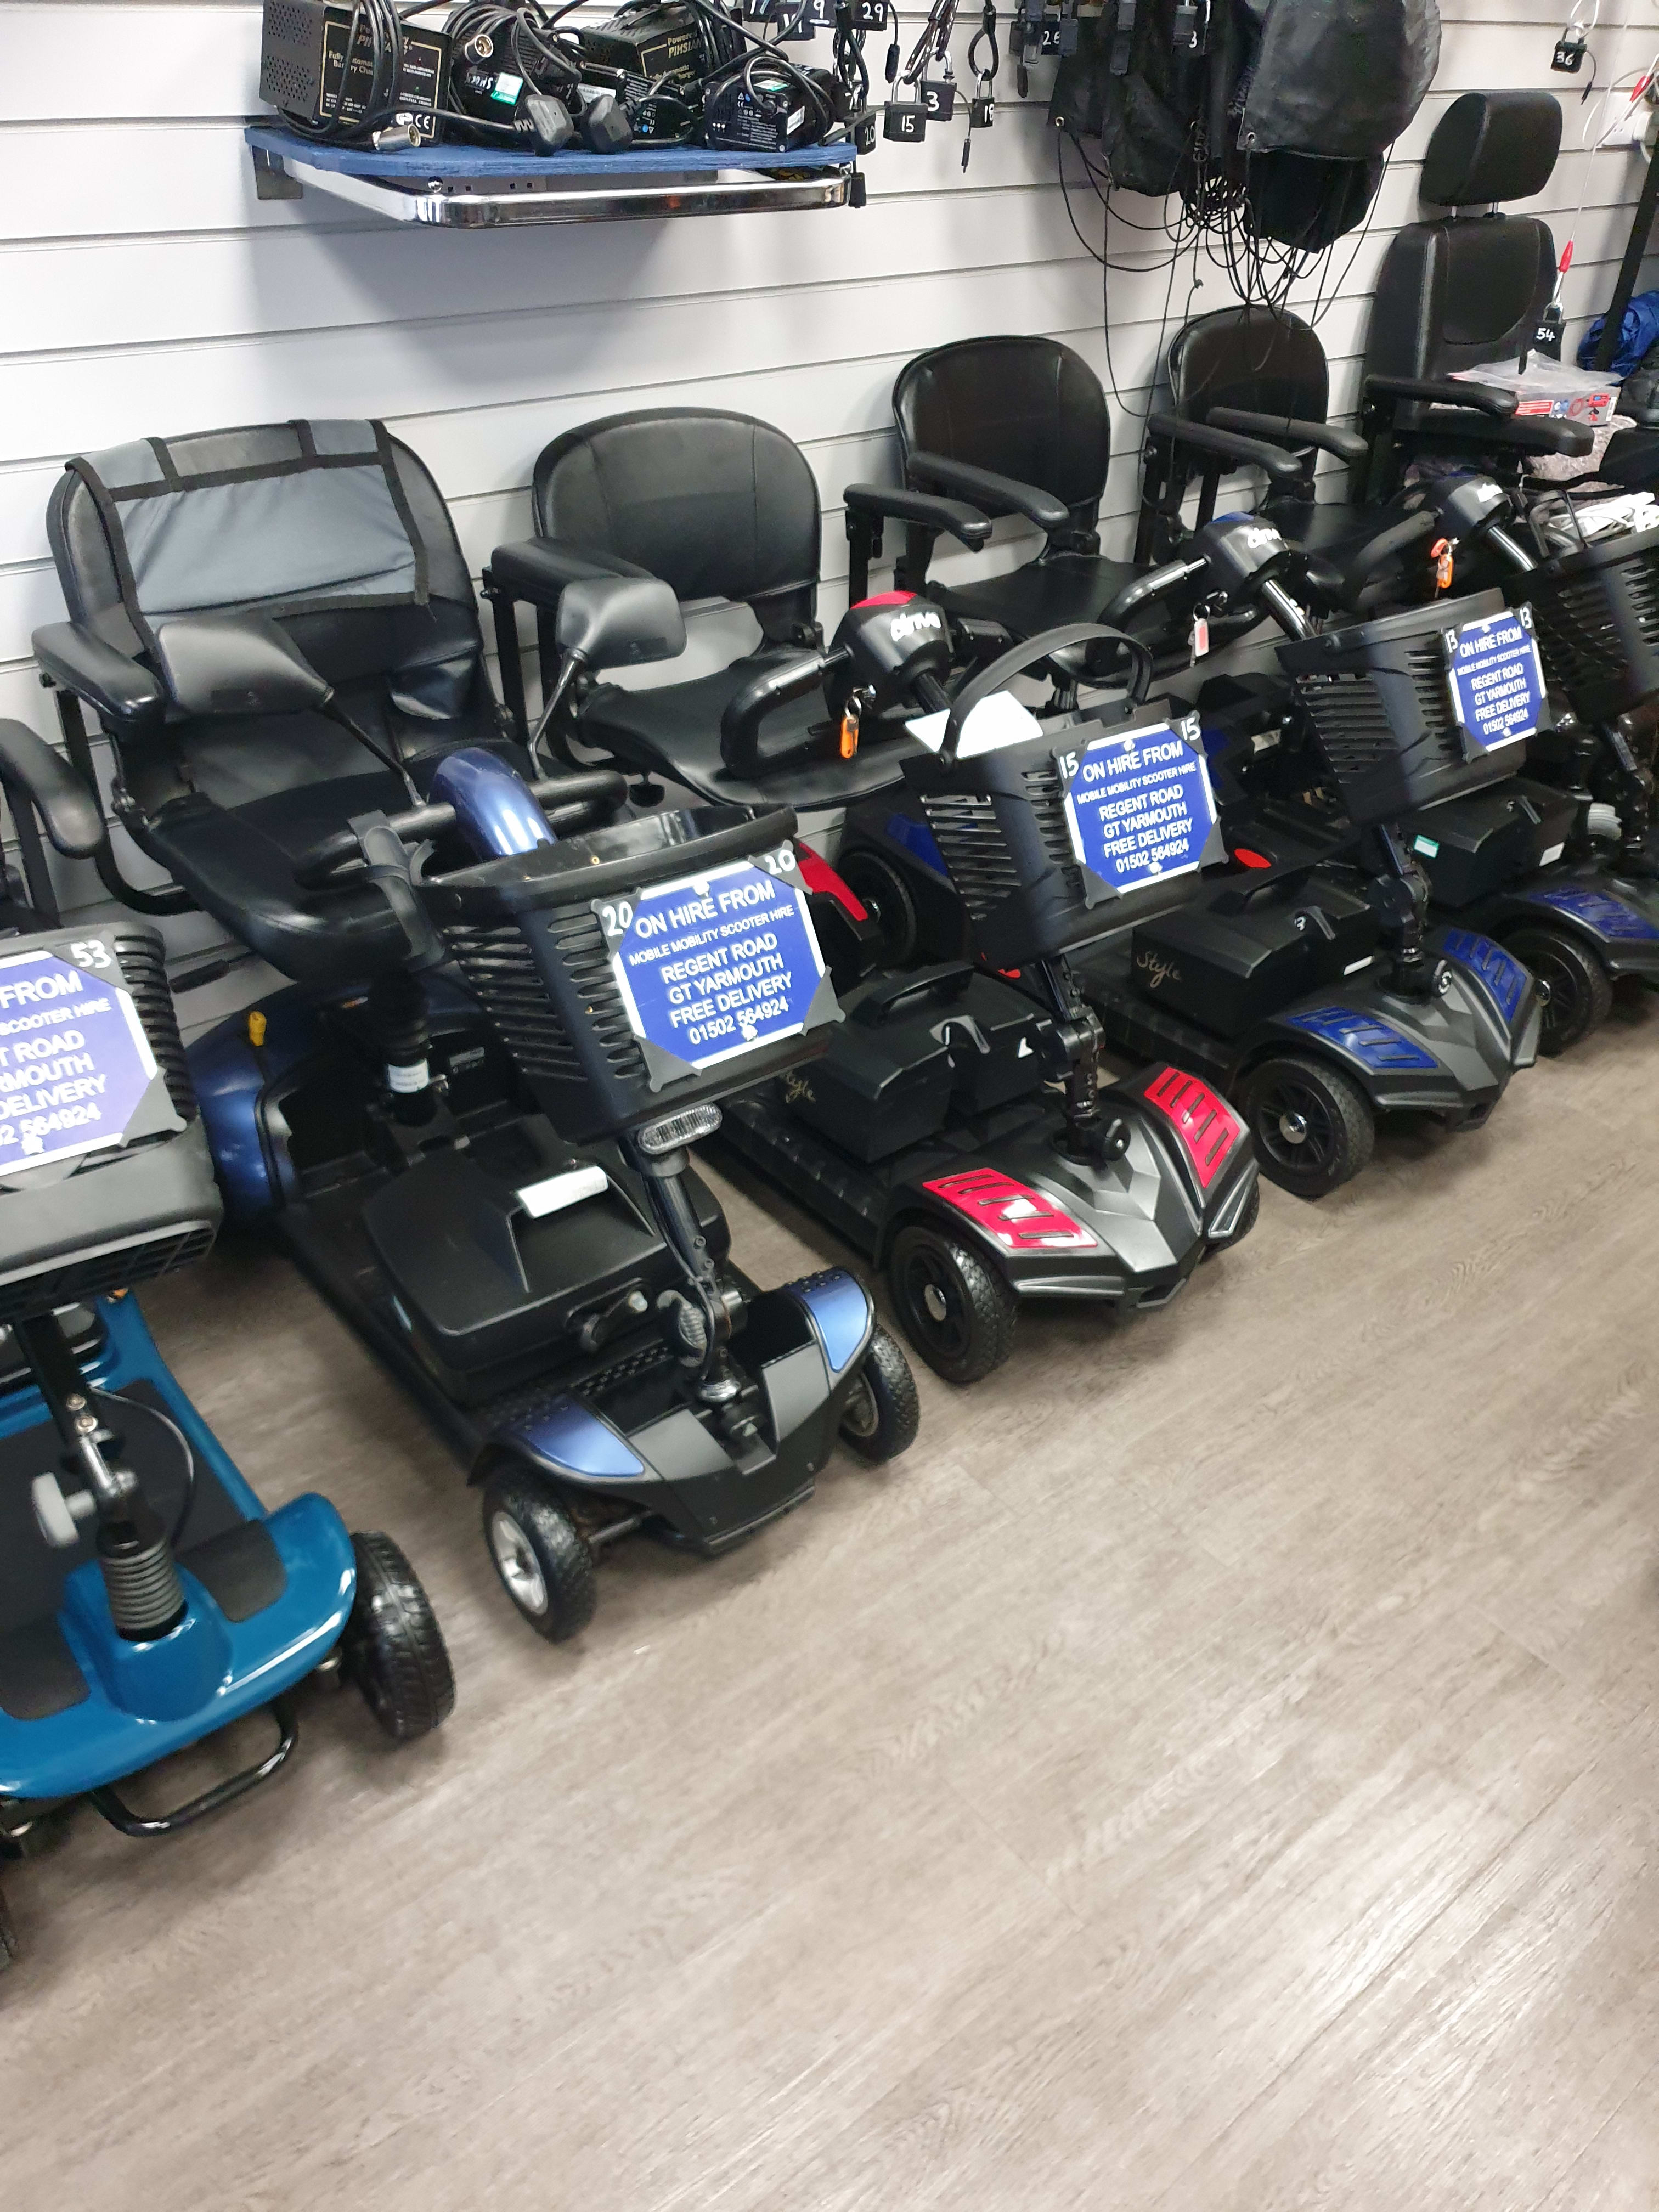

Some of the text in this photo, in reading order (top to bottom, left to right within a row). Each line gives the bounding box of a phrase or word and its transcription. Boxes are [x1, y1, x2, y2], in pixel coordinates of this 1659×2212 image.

[861, 2, 883, 22] 29
[1556, 51, 1575, 66] 36
[926, 91, 940, 111] 3
[865, 125, 876, 146] 20
[901, 115, 915, 132] 15
[1536, 328, 1556, 342] 54
[1520, 607, 1532, 629] 13
[1445, 629, 1458, 653] 13
[1460, 627, 1522, 658] ON HIRE FROM
[1471, 663, 1523, 691] REGENT ROAD
[1475, 678, 1527, 706] GT YARMOUTH
[1475, 691, 1530, 722] FREE DELIVERY
[1483, 708, 1528, 735] 01502 564924
[1181, 717, 1201, 740] 15
[1059, 751, 1079, 779] 15
[1082, 741, 1183, 782] ON HIRE FROM
[1077, 761, 1196, 804] MOBILE MOBILITY SCOOTER HIRE
[1099, 784, 1183, 821] REGENT ROAD
[1104, 802, 1187, 839] GT YARMOUTH
[1103, 817, 1193, 858] FREE DELIVERY
[765, 849, 796, 876] 20
[1116, 838, 1189, 873] 01502 564924
[603, 902, 633, 936] 20
[635, 880, 775, 939] ON HIRE FROM
[629, 905, 794, 966] MOBILE MOBILITY SCOOTER HIRE
[70, 940, 111, 968] 53
[661, 933, 777, 984] REGENT ROAD
[0, 970, 83, 1009] FROM
[669, 953, 784, 1004] GT YARMOUTH
[74, 998, 112, 1018] HIRE
[670, 972, 792, 1028] FREE DELIVERY
[689, 996, 788, 1045] 01502 564924
[13, 1030, 85, 1063] ROAD
[20, 1102, 101, 1136] 564924
